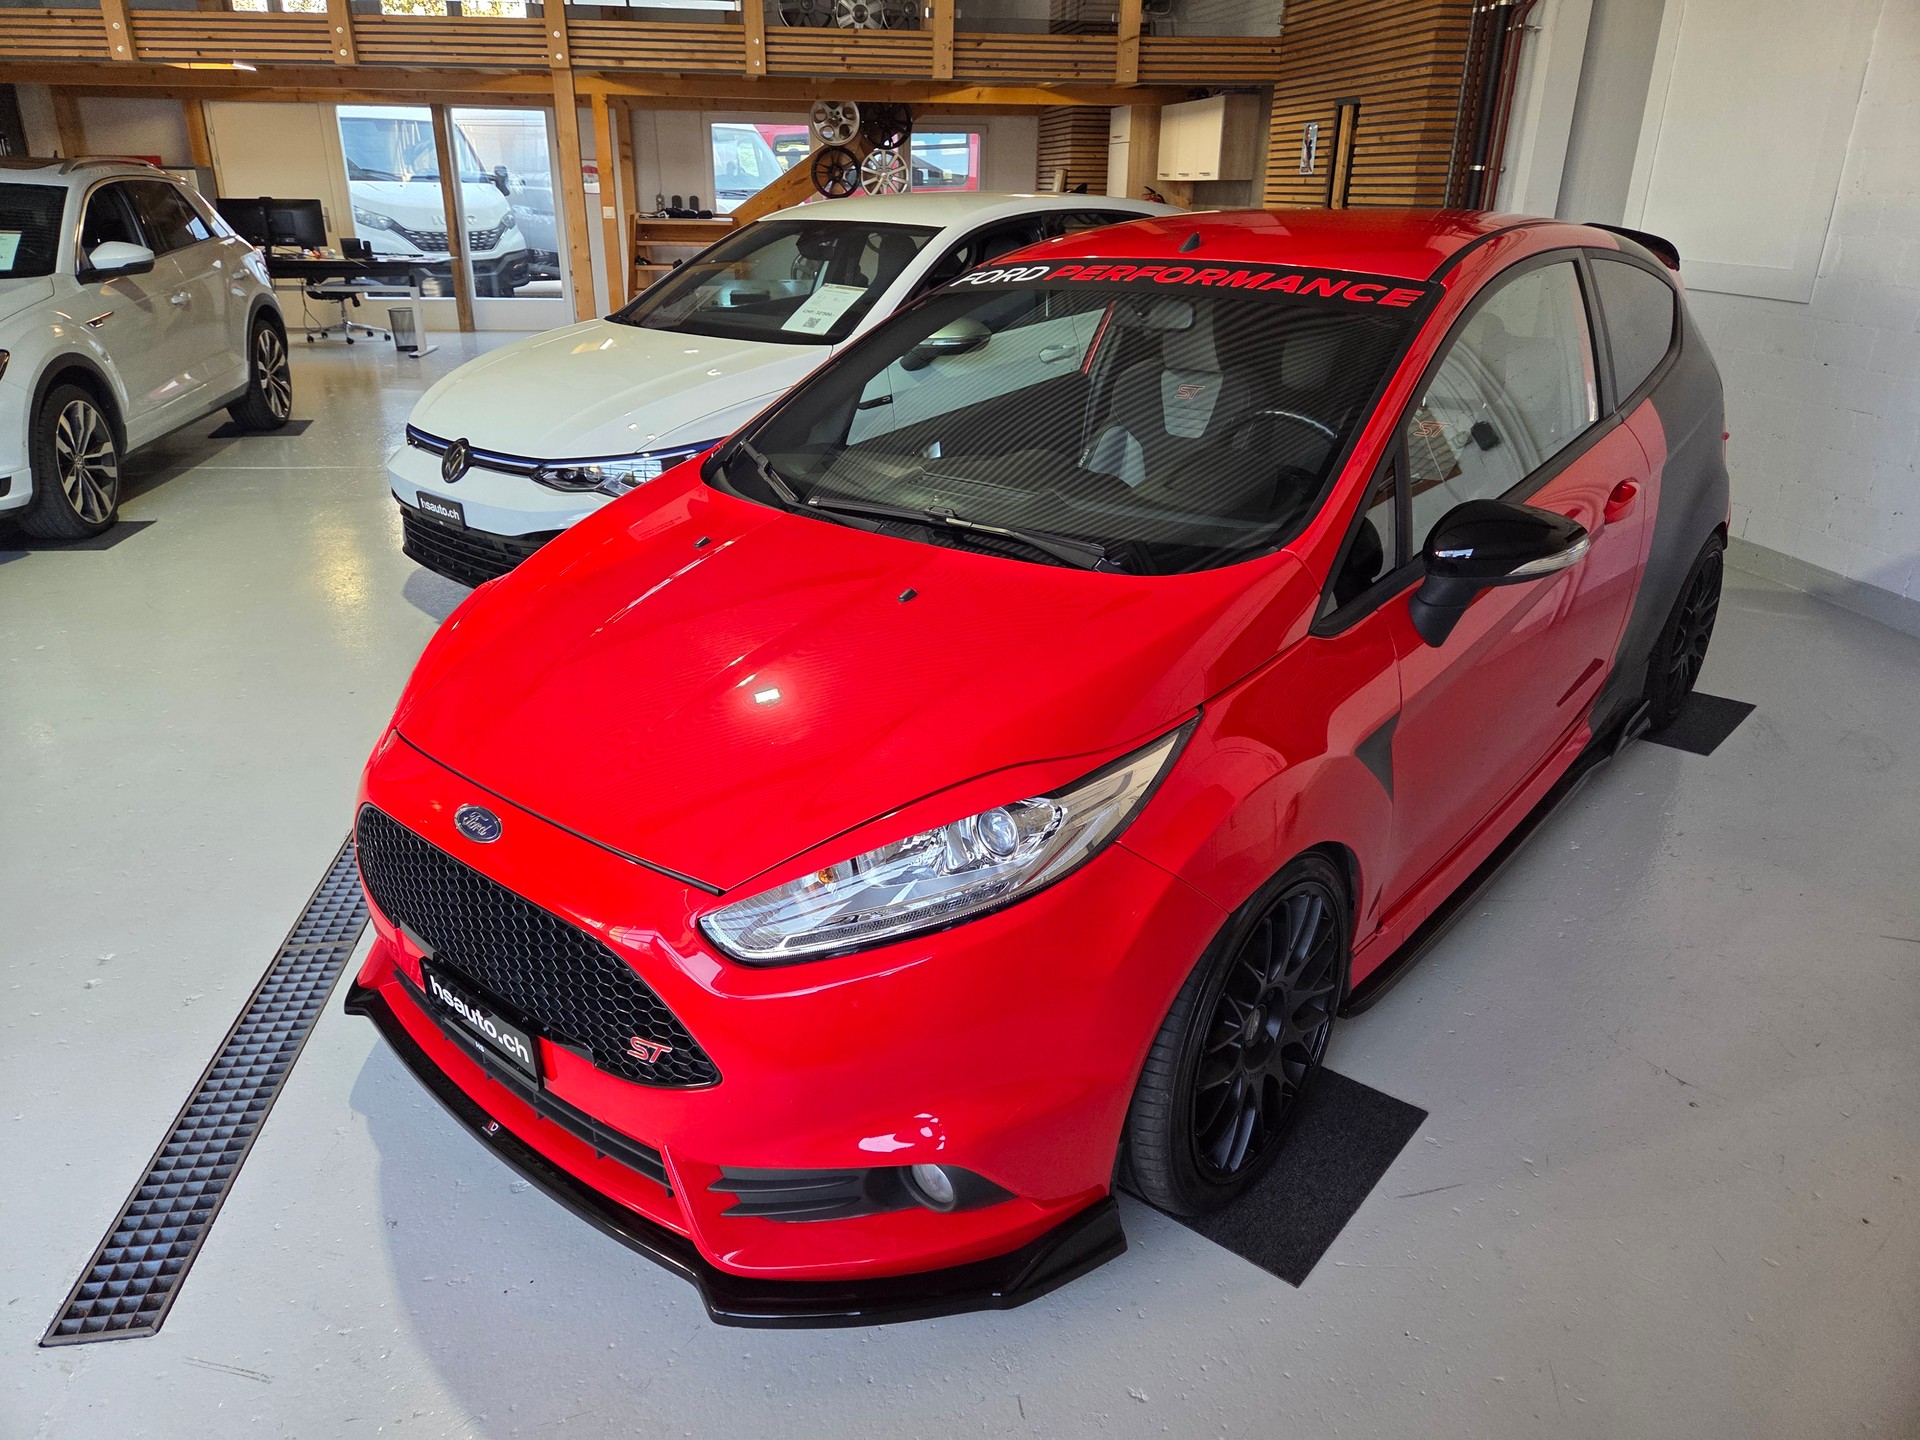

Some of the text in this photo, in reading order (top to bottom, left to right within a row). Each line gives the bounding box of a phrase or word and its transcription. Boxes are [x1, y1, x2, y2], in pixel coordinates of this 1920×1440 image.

[949, 265, 1427, 307] FORD PERFORMANCE
[1174, 384, 1206, 399] ST
[1413, 421, 1453, 437] ST
[420, 497, 460, 520] hsauto.ch
[462, 811, 493, 836] Ford
[429, 974, 530, 1064] hsauto.ch
[627, 1036, 673, 1063] ST
